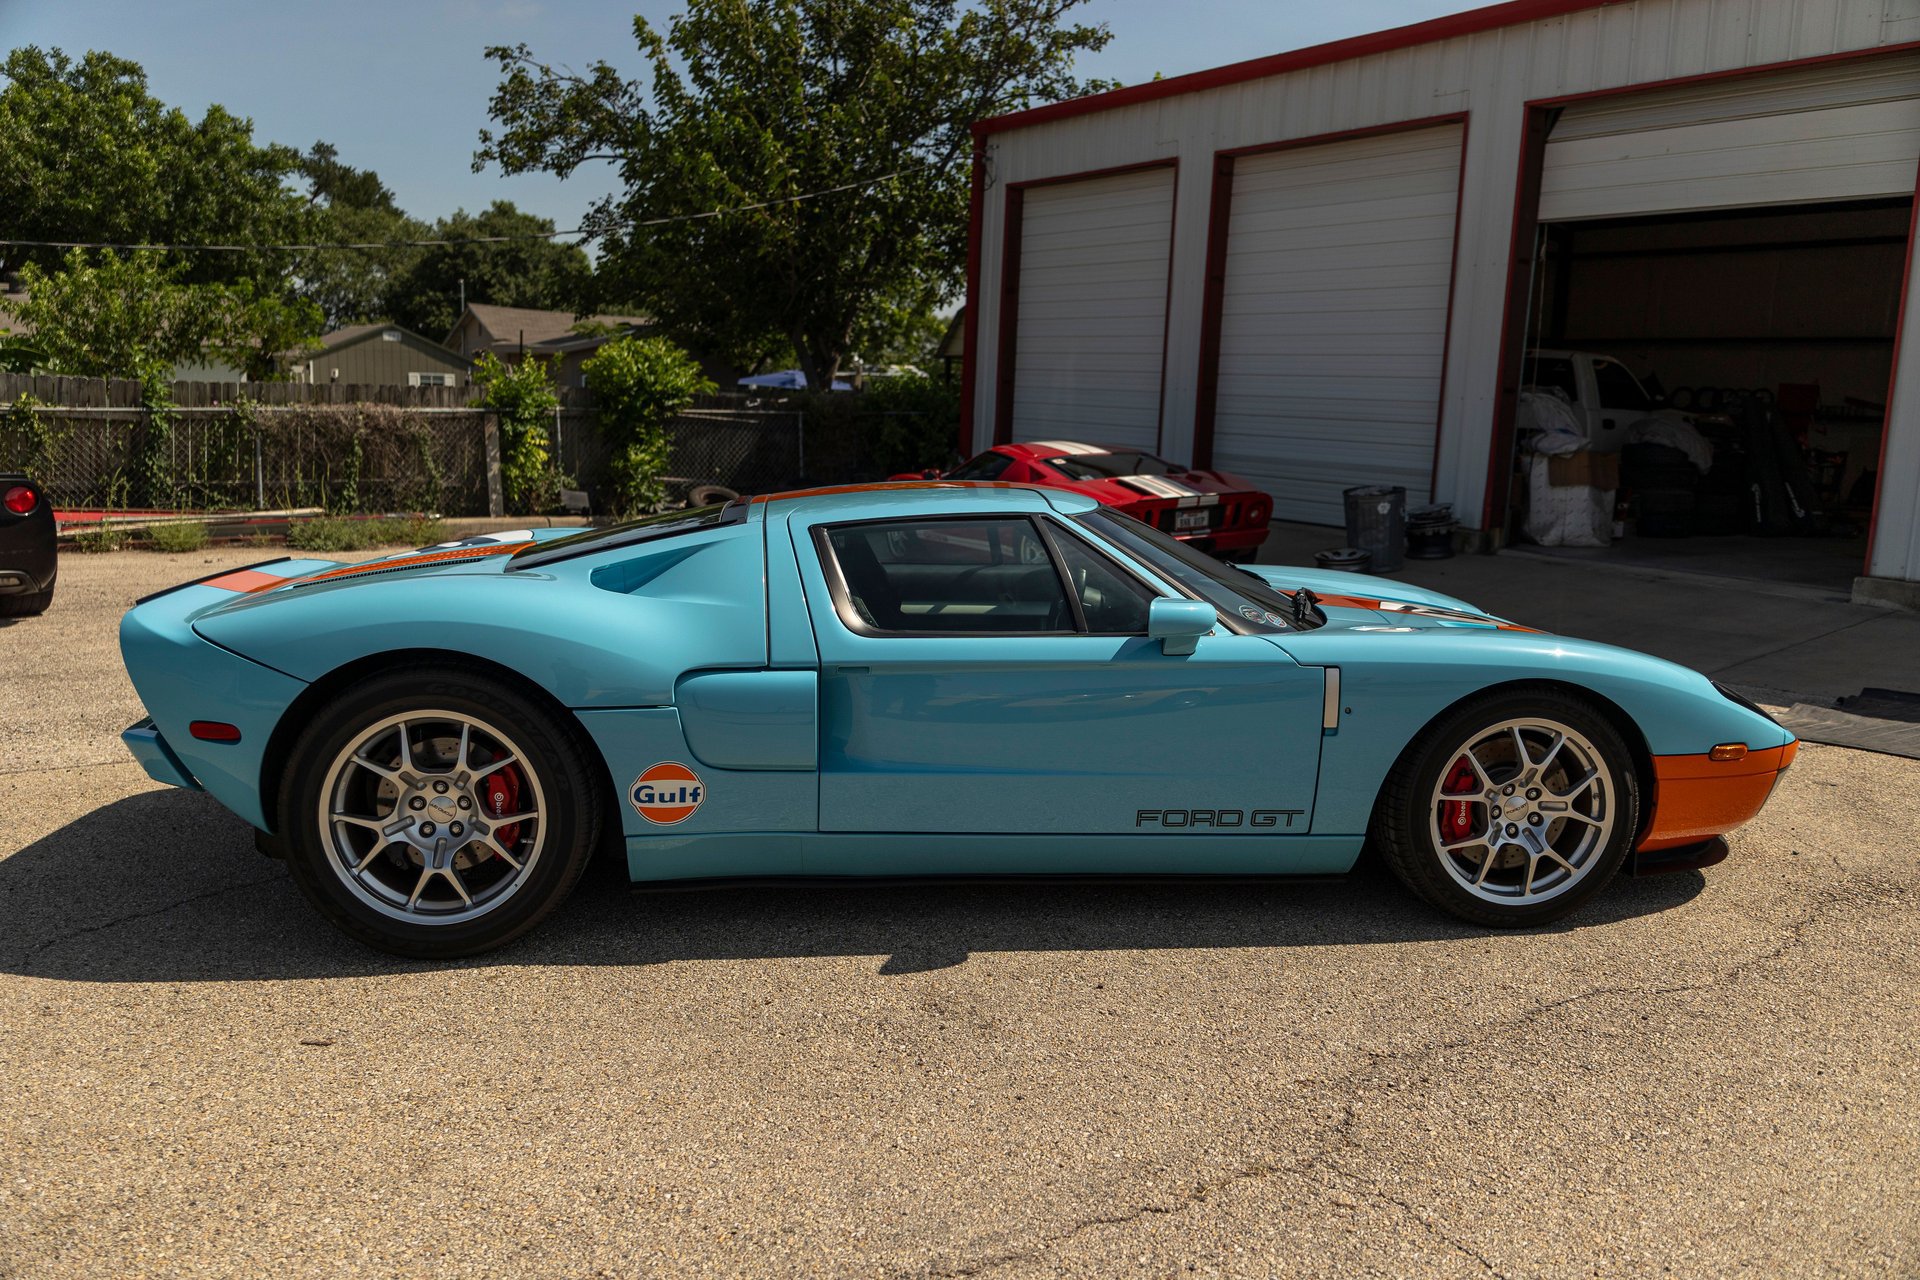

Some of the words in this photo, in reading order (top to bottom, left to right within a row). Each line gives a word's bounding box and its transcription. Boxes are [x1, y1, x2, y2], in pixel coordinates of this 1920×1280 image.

[634, 785, 700, 803] Gulf
[1136, 810, 1243, 827] FORD
[1251, 810, 1304, 827] GT
[1506, 807, 1520, 815] FORD
